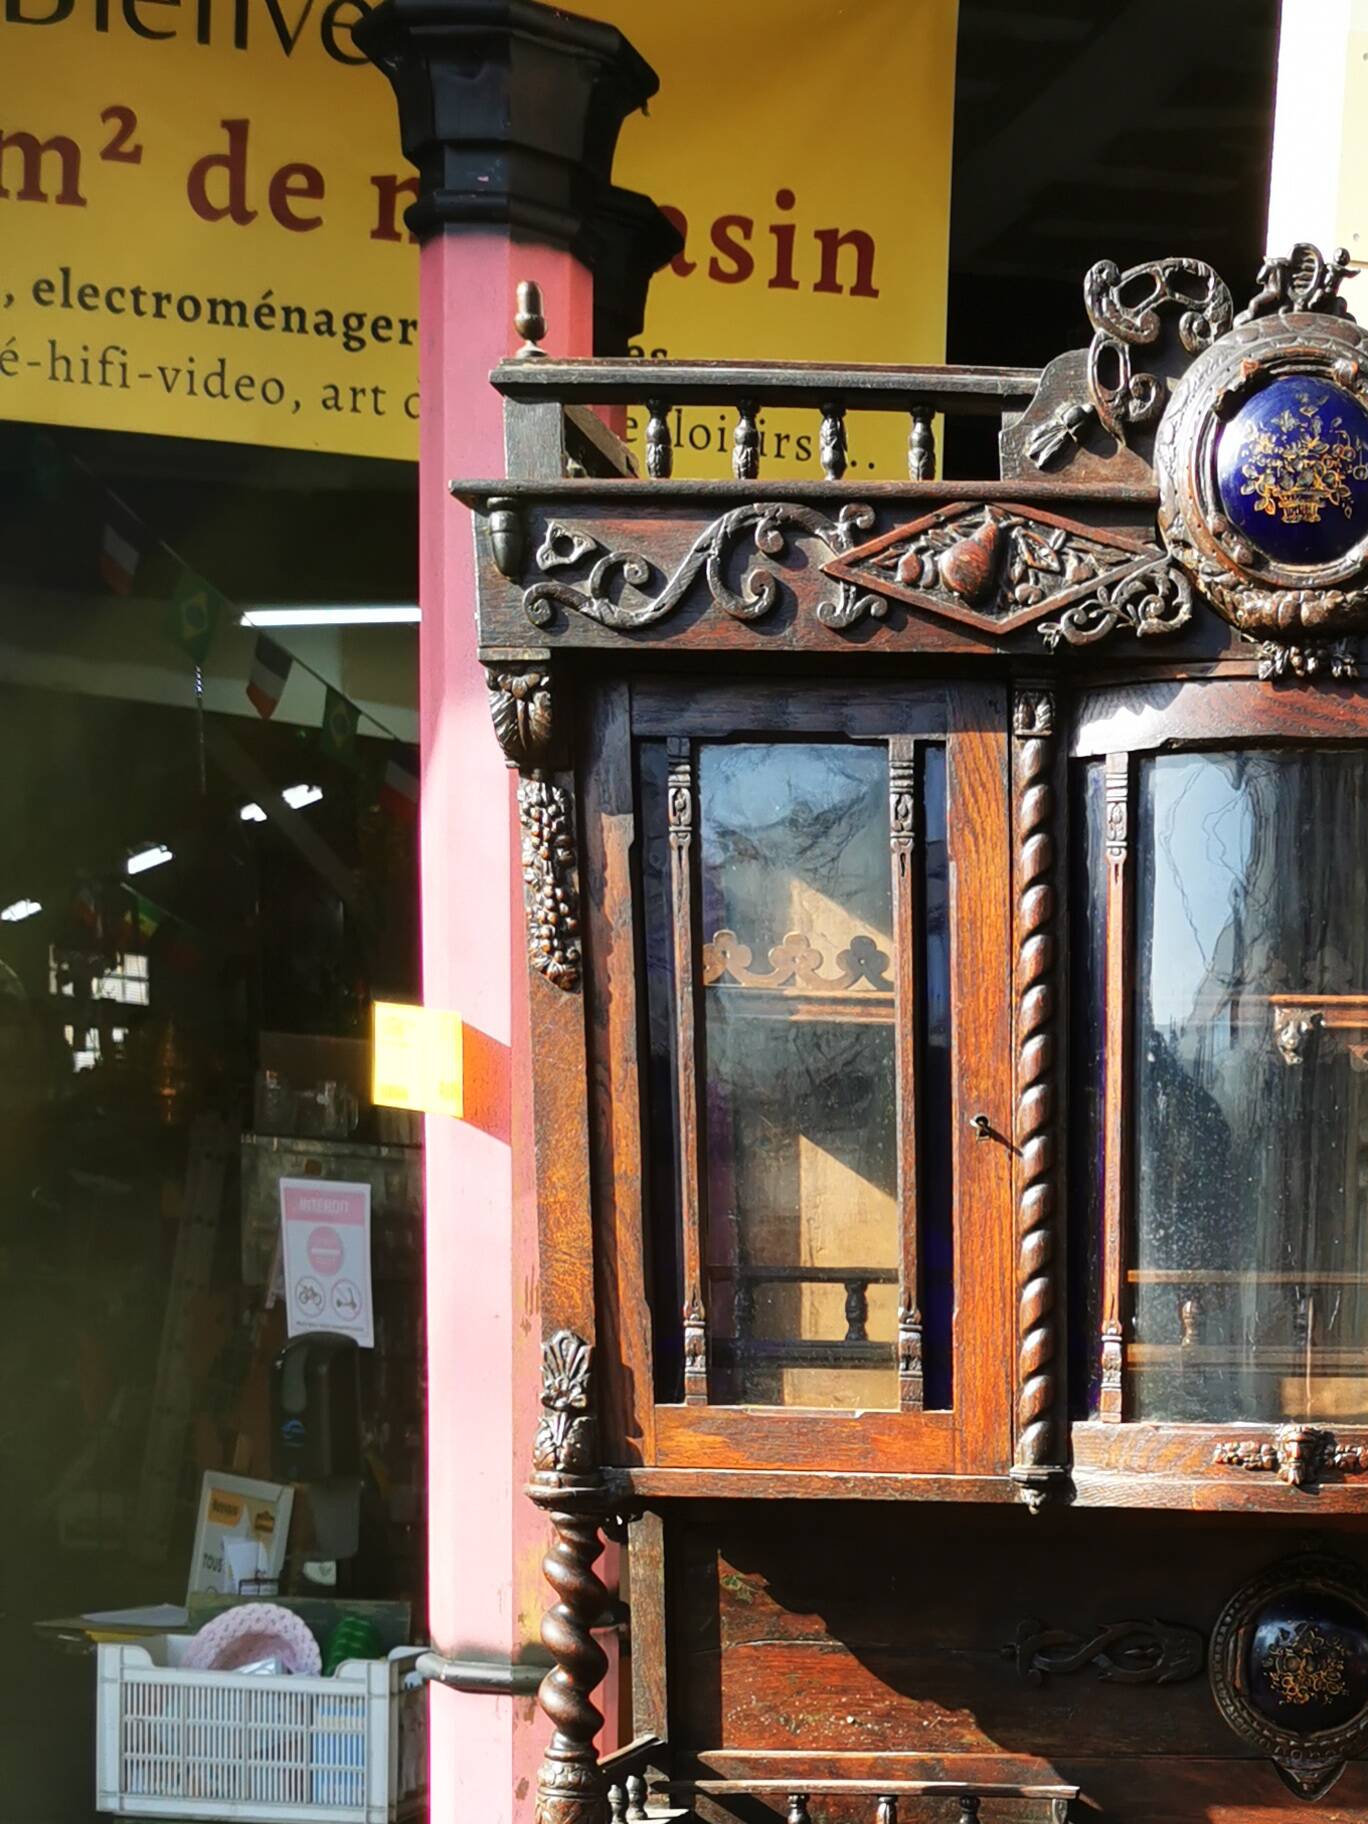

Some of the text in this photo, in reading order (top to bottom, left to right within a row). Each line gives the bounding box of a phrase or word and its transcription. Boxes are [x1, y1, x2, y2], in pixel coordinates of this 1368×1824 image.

[187, 118, 325, 233] de
[32, 267, 418, 352] electroménager
[321, 383, 386, 416] art
